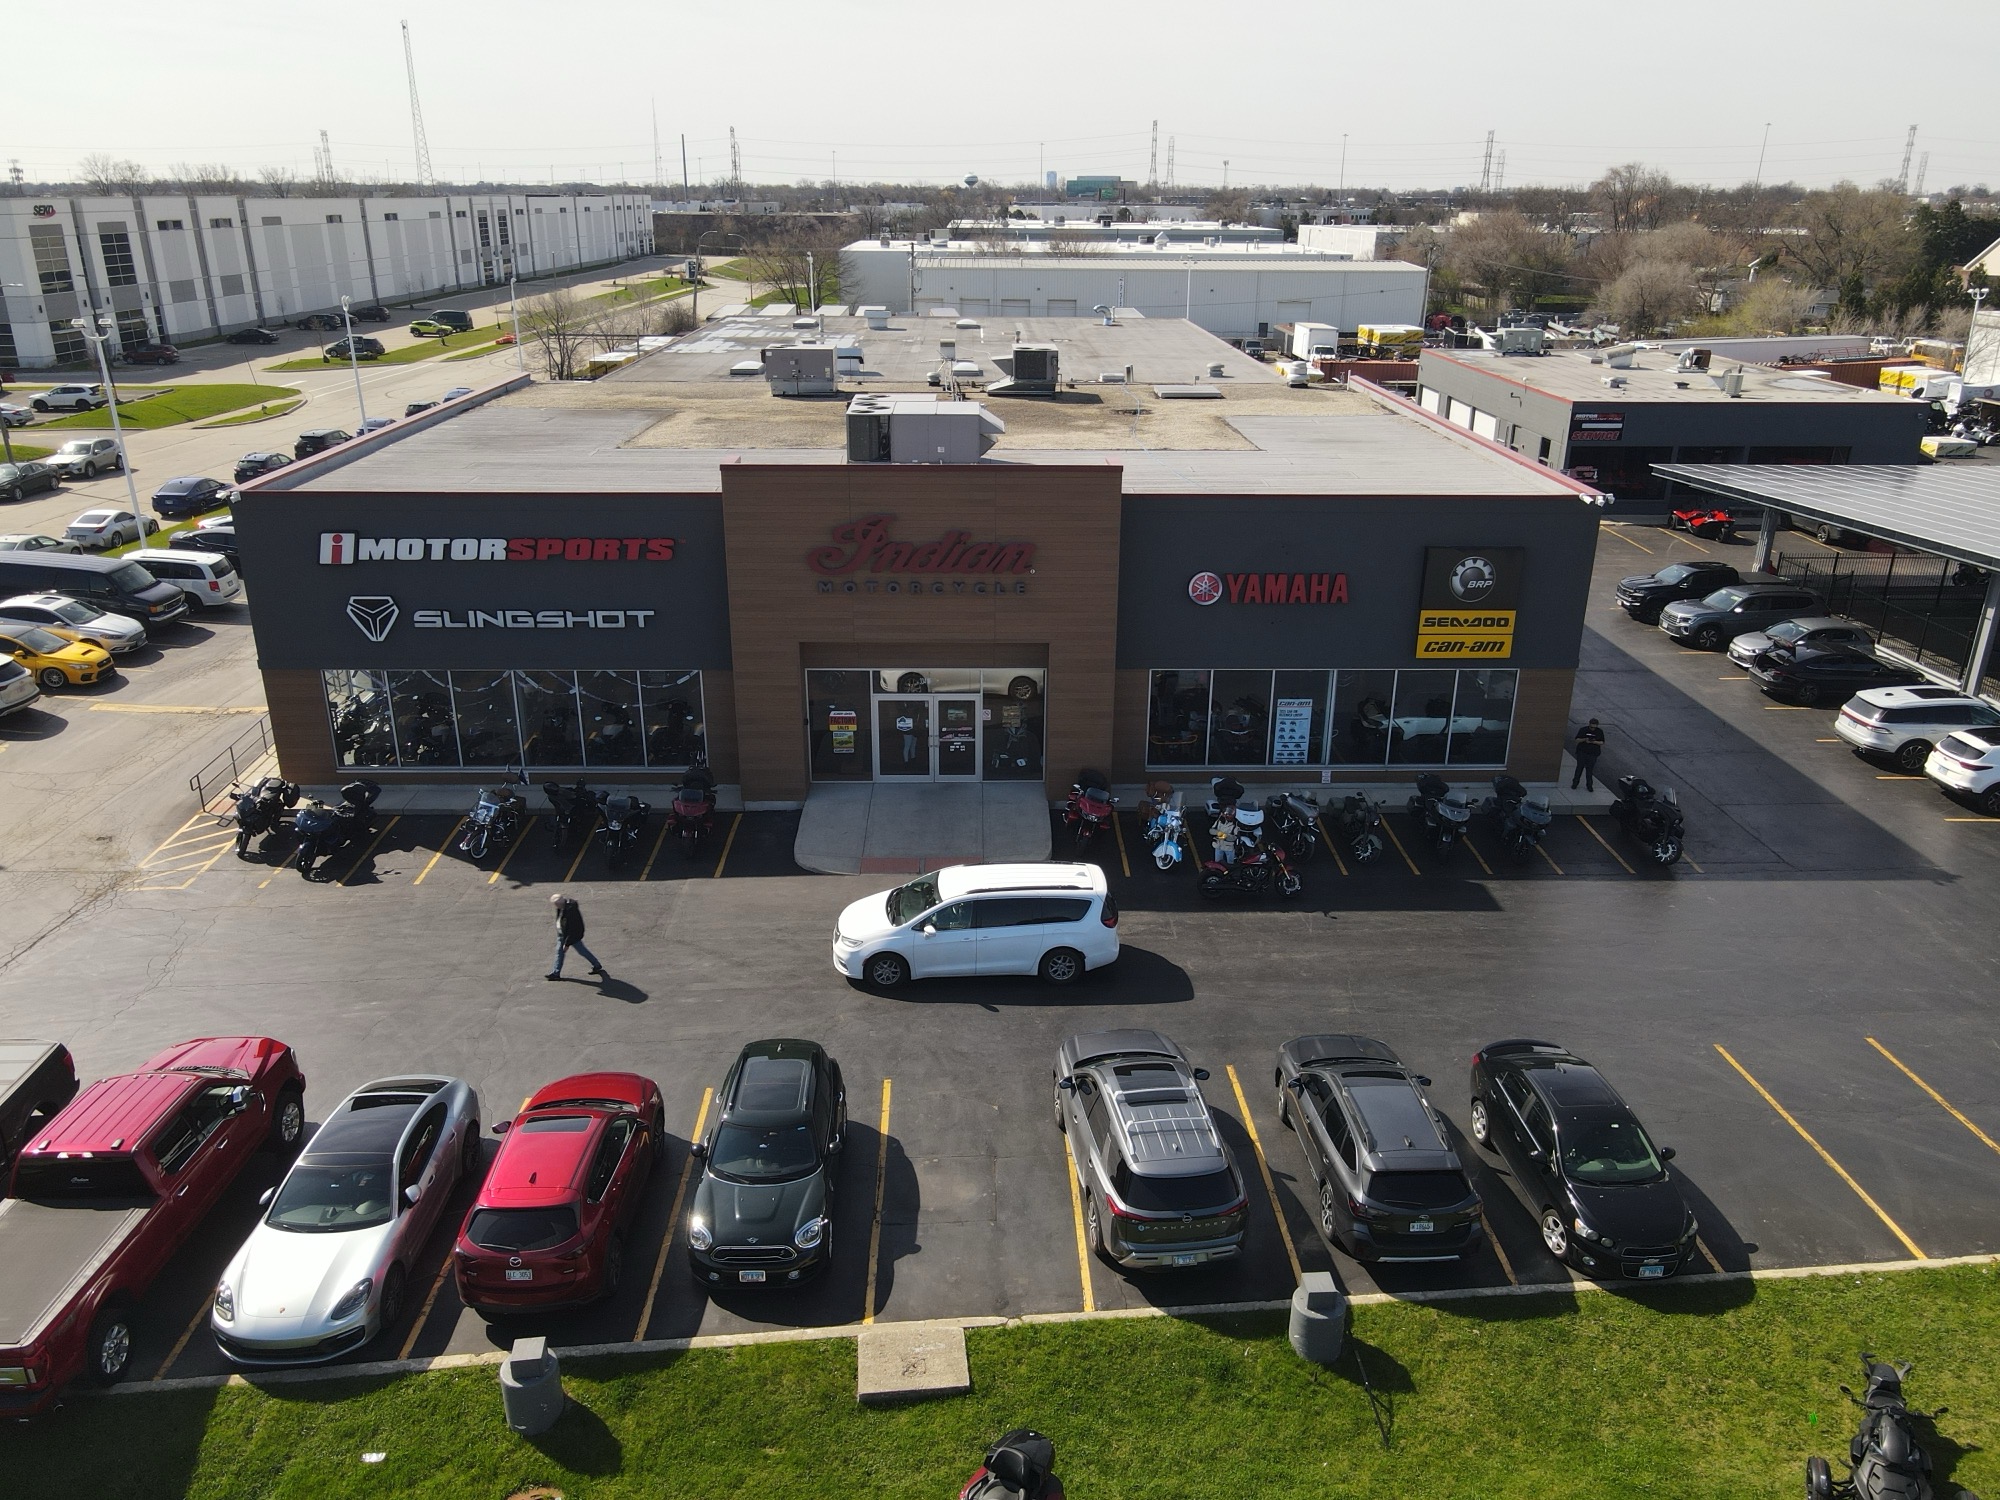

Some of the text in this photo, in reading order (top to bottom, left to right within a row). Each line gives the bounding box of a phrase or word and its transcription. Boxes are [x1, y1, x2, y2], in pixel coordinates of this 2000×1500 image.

[1571, 430, 1620, 441] SERVICE
[807, 513, 1036, 575] Indian
[817, 580, 1026, 596] MOTORCYCLE
[1226, 572, 1349, 604] YAMAHA
[1467, 579, 1493, 590] BRP
[413, 609, 656, 629] SLINGSHOT
[1423, 639, 1506, 654] can-am
